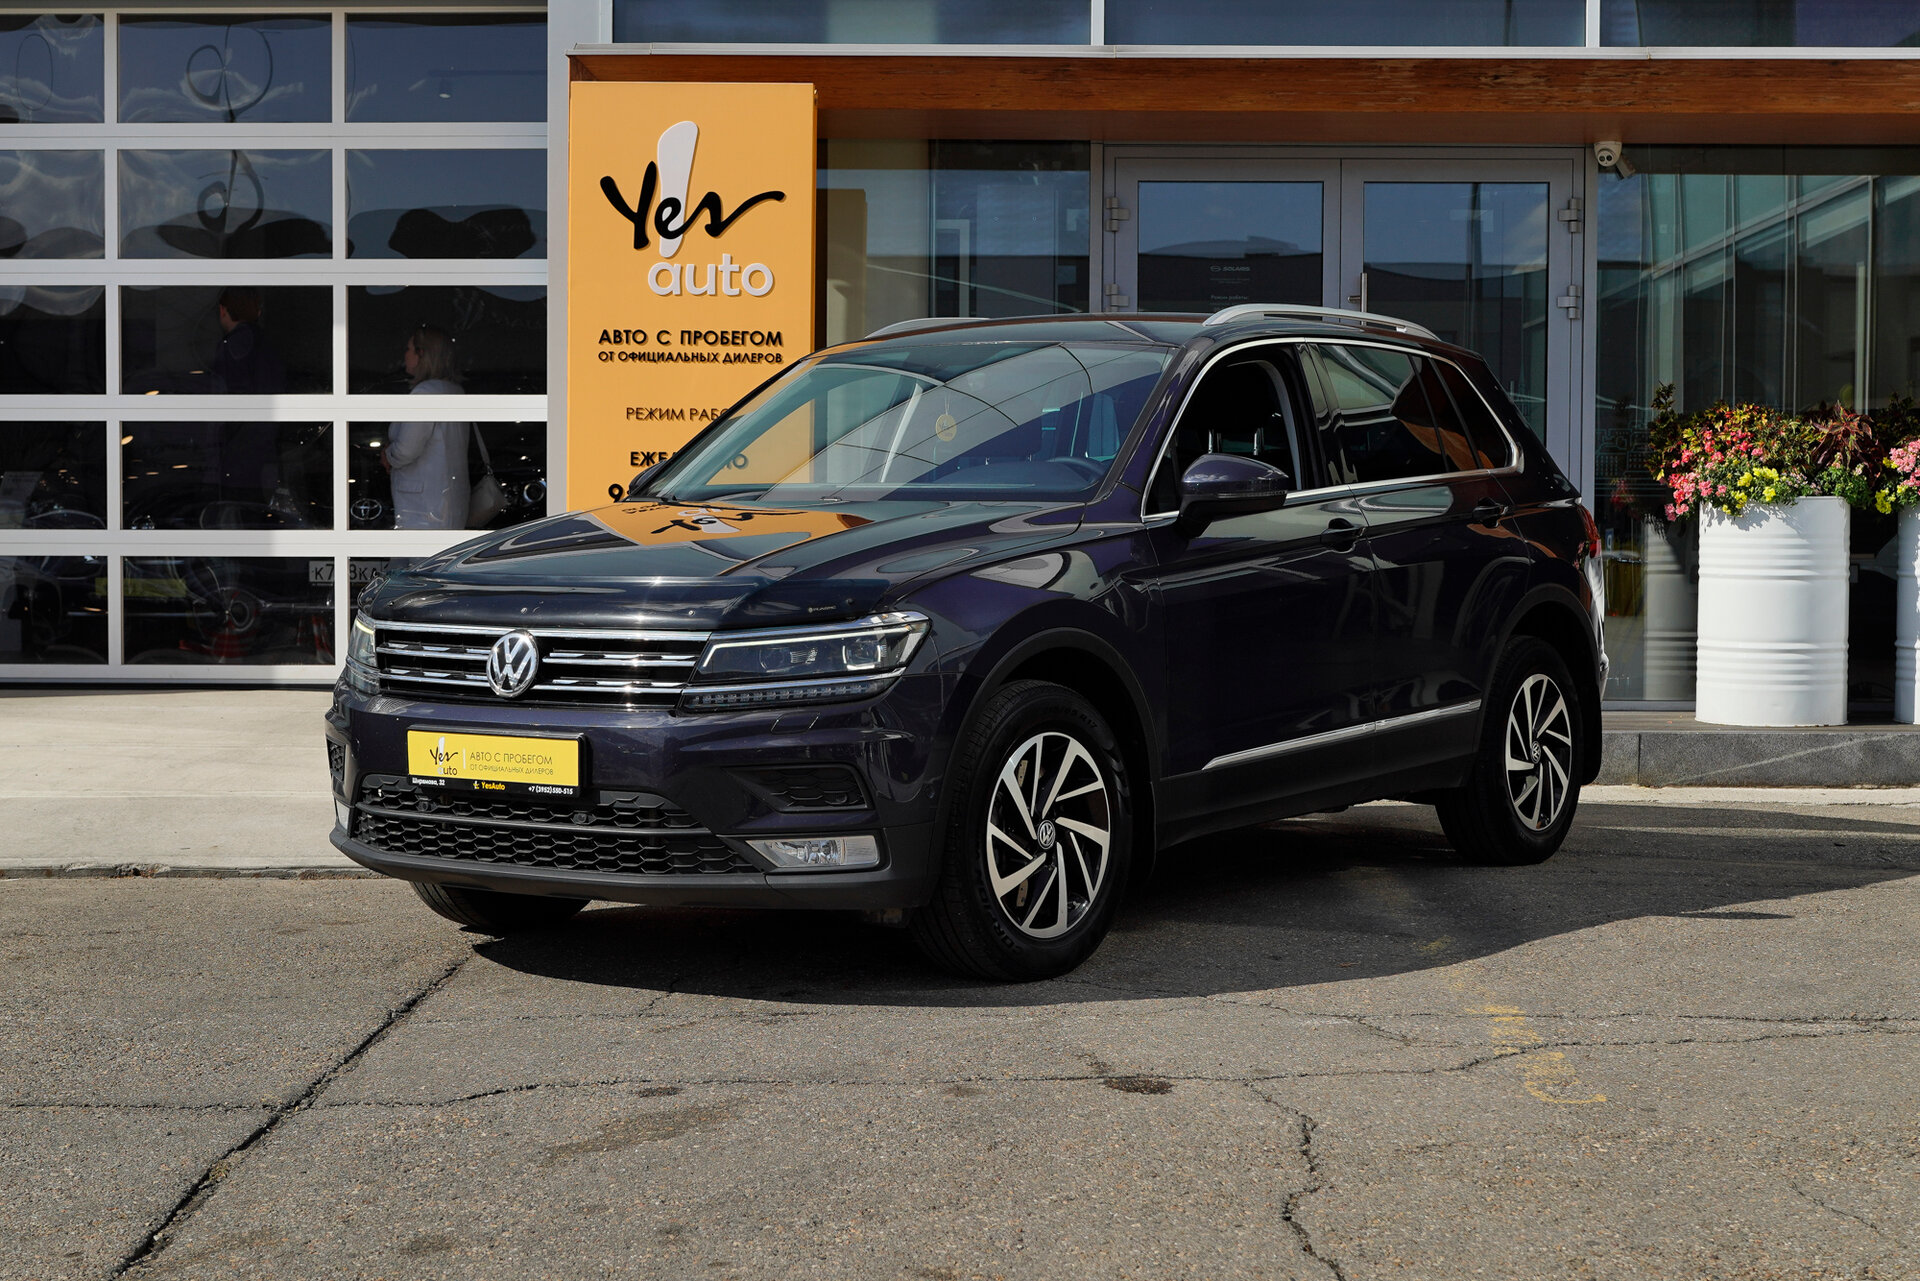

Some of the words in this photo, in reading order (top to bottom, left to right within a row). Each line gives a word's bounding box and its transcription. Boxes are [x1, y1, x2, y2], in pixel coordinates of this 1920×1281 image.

[600, 160, 784, 250] Yes
[648, 253, 774, 296] auto
[598, 329, 648, 345] АВТО
[656, 330, 672, 345] С
[680, 330, 783, 346] ПРОБЕГОМ
[598, 351, 615, 362] ОТ
[618, 351, 719, 363] ОФИЦИАЛЬНЫХ
[722, 353, 783, 364] ДИЛЕРОВ
[626, 407, 685, 421] РЕЖИМ
[429, 746, 459, 765] Yes
[469, 752, 492, 762] АВТО
[494, 753, 501, 762] С
[503, 753, 553, 765] ПРОБЕГОМ
[437, 766, 458, 776] auto
[479, 764, 524, 774] ОФИЦИАЛЬНЫХ
[525, 767, 554, 775] ДИЛЕРОВ
[481, 781, 506, 790] YesAuto
